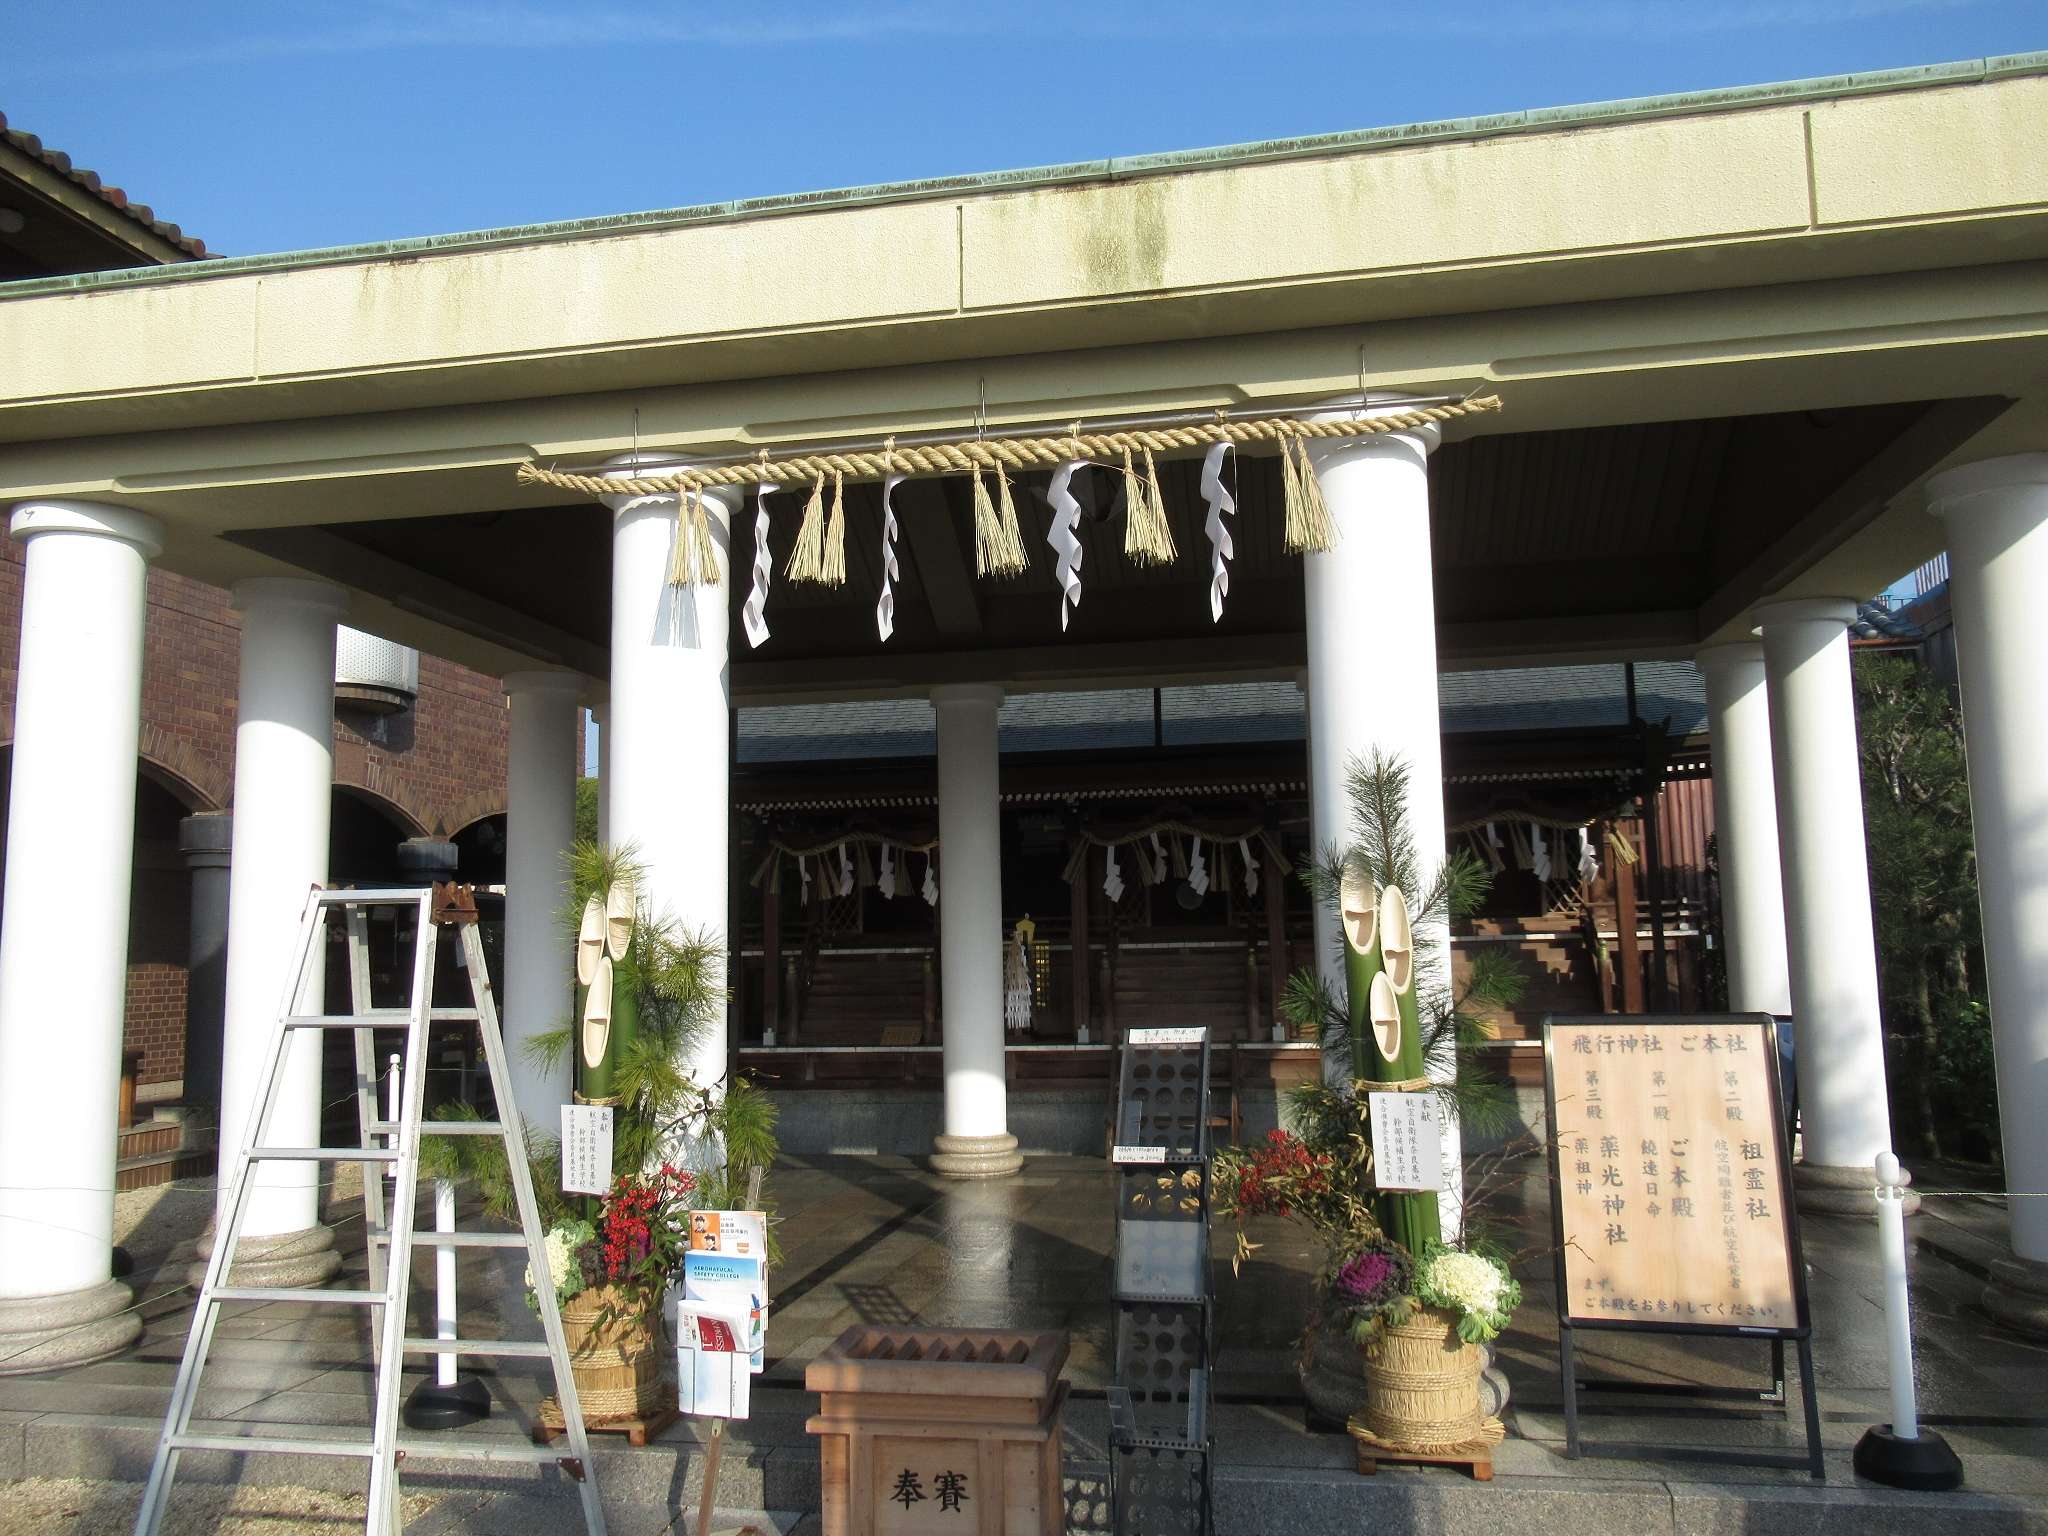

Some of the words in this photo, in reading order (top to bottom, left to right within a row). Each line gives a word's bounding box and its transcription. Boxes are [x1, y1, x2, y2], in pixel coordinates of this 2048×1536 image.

[1572, 1033, 1663, 1054] 飛行神社
[1680, 1034, 1748, 1053] ご本社
[1585, 1070, 1603, 1120] 第三殿
[1652, 1070, 1671, 1121] 第一殿
[1723, 1070, 1744, 1121] 第二殿
[1574, 1138, 1592, 1195] 薬祖神
[1600, 1136, 1629, 1246] 薬光神社
[1671, 1136, 1696, 1218] ご本殿
[1739, 1139, 1771, 1221] 祖霊社
[1584, 1298, 1779, 1319] ご本殿をお参りしてください。
[889, 1468, 970, 1513] 奉賽
